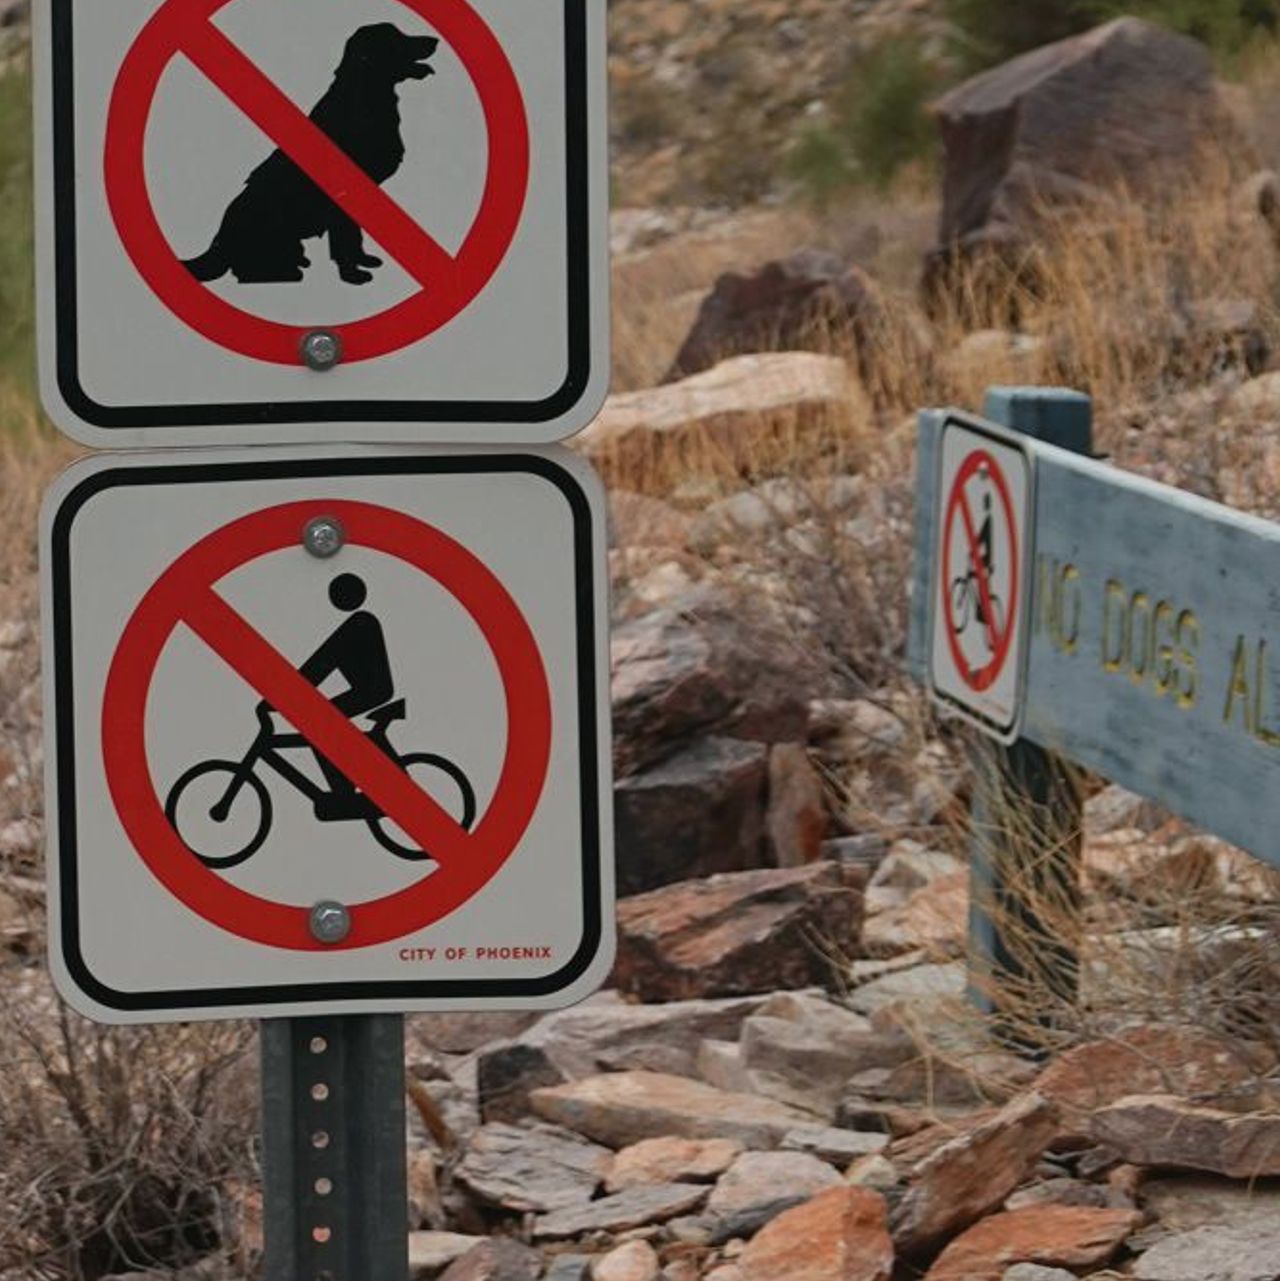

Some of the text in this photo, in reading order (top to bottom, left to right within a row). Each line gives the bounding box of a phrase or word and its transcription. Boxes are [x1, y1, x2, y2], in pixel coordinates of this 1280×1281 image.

[1036, 554, 1080, 656] NO
[1103, 578, 1200, 710] DOGS
[399, 946, 551, 961] CITY OF PHOENIX
